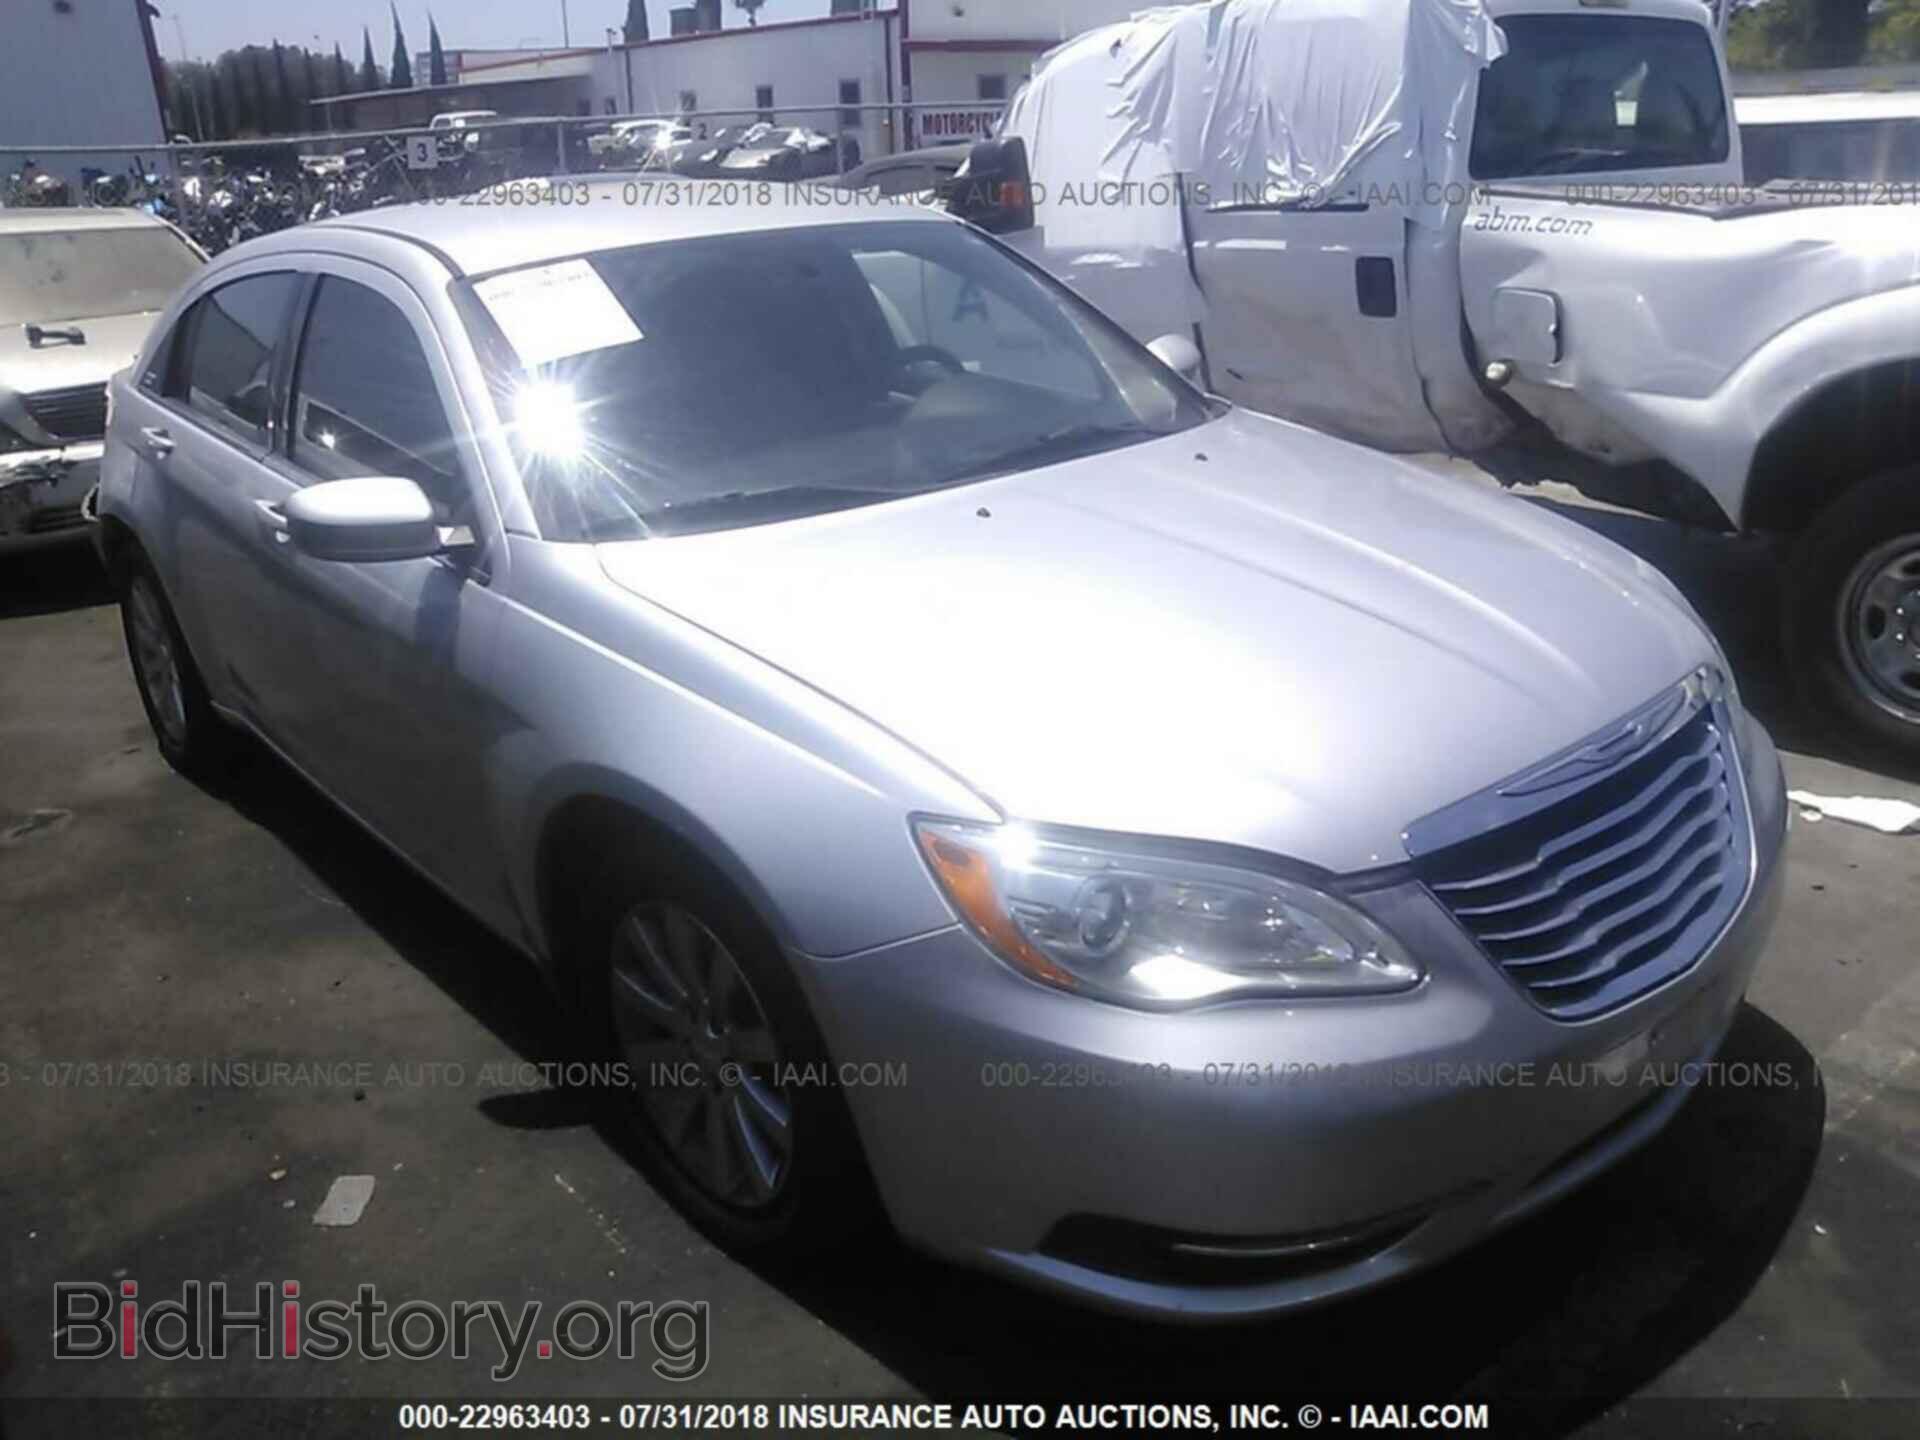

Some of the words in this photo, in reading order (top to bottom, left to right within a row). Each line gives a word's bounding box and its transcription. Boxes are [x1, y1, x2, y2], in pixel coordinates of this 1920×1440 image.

[697, 122, 708, 141] 2
[922, 111, 1001, 136] MOTORCYC
[417, 143, 428, 162] 3
[1474, 206, 1593, 235] abm.com
